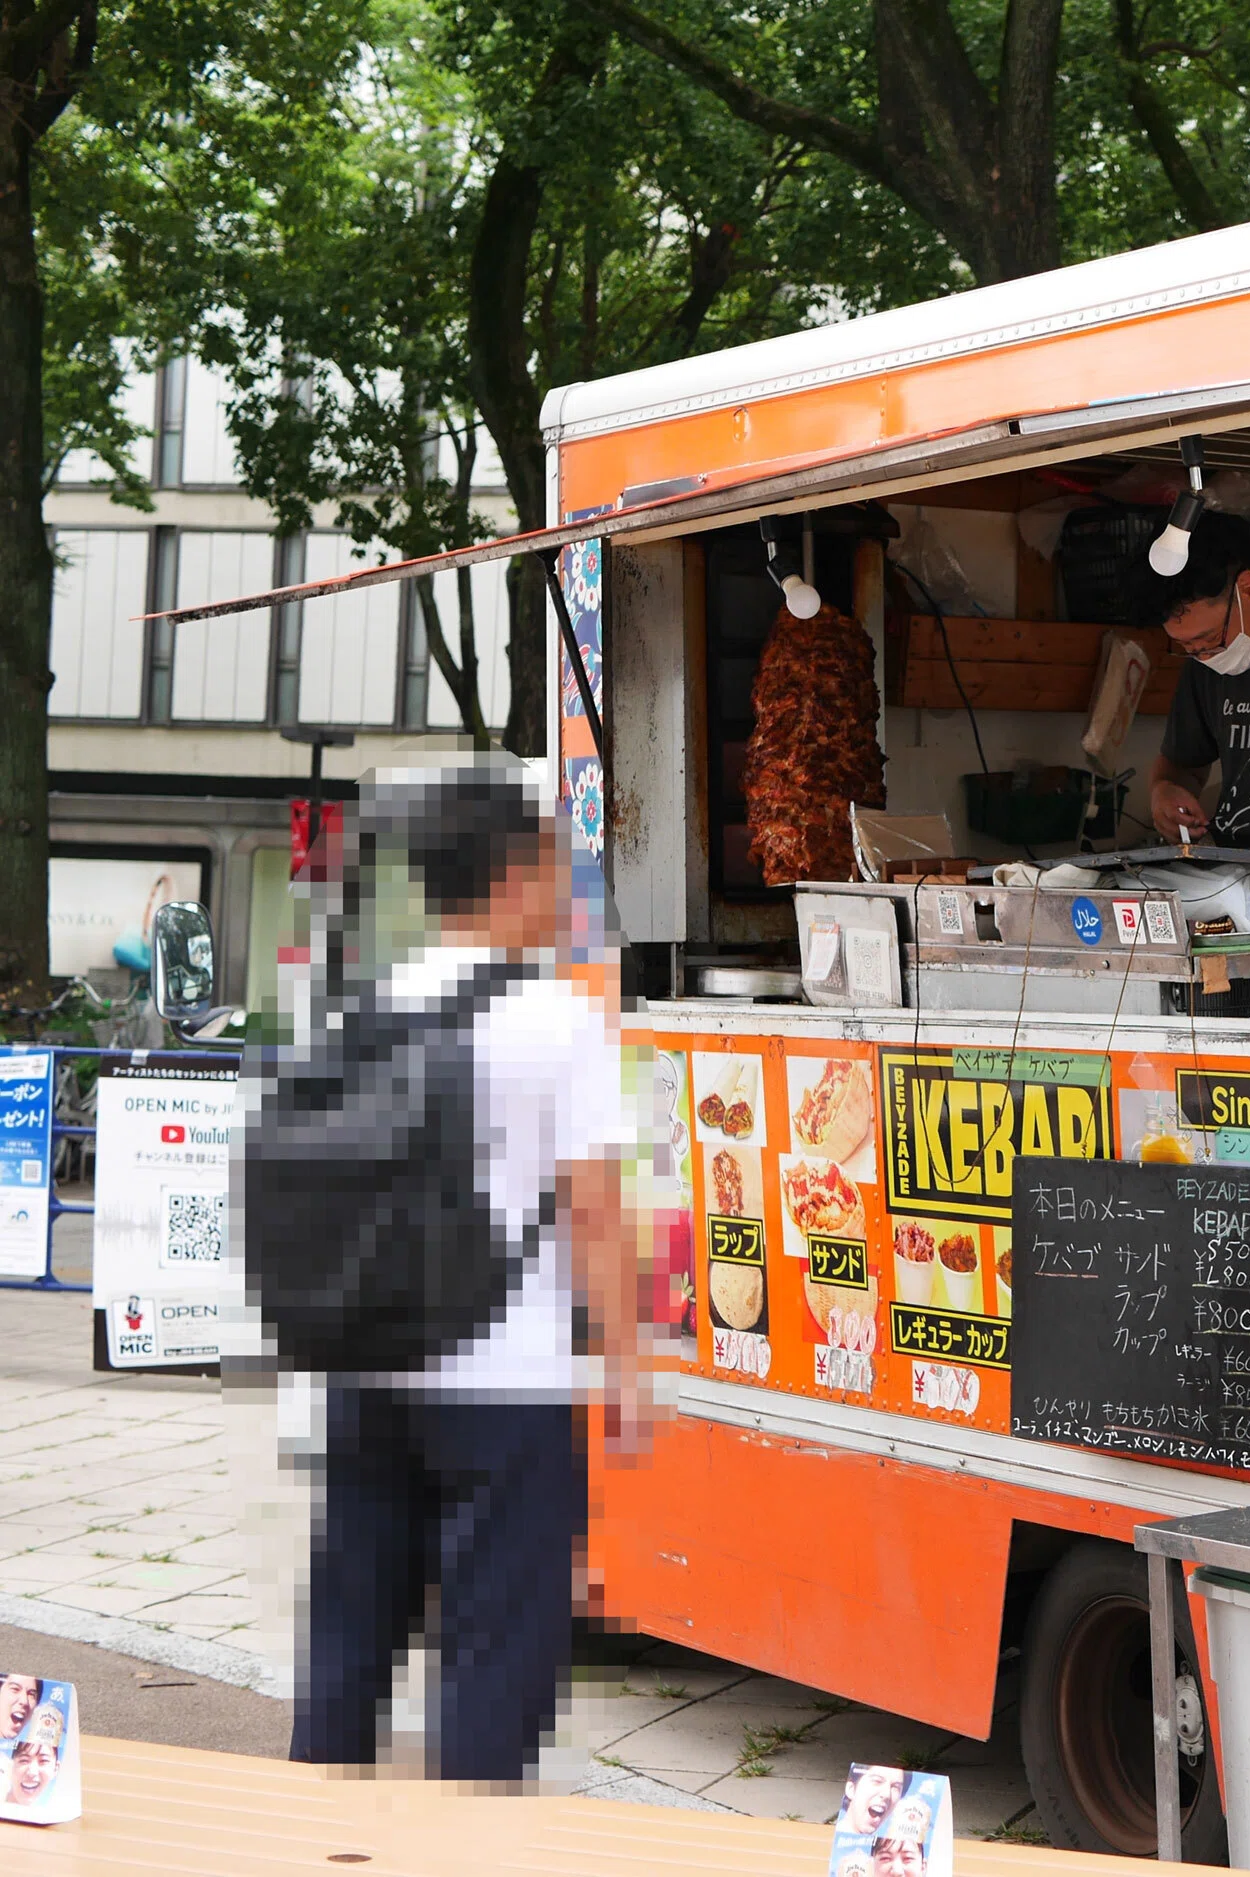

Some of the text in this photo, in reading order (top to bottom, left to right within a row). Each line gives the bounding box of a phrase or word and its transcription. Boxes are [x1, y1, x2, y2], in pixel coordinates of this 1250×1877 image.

[1223, 699, 1234, 716] le
[1074, 908, 1099, 930] حلال
[1029, 1056, 1075, 1080] ケバブ
[0, 1108, 45, 1128] ゼント!
[125, 1097, 167, 1113] OPEN
[172, 1099, 201, 1113] MIC
[204, 1103, 217, 1116] by
[894, 1067, 910, 1195] BEYZADE
[1176, 1178, 1250, 1202] BEYZADE
[1029, 1182, 1165, 1223] 本日のメニュー
[713, 1223, 760, 1258] ラップ
[812, 1243, 862, 1280] サンド
[1032, 1234, 1171, 1281] ケバブ サンド
[161, 1305, 218, 1319] OPEN
[1114, 1285, 1168, 1321] ラップ
[119, 1334, 152, 1342] OPEN
[120, 1342, 152, 1354] MIC
[898, 1315, 1008, 1360] レギュラー カップ
[1112, 1326, 1167, 1356] カップ
[1175, 1345, 1212, 1361] レギュラー
[1176, 1374, 1211, 1392] ラージ
[1033, 1397, 1212, 1433] ひんやり もちもちかき氷
